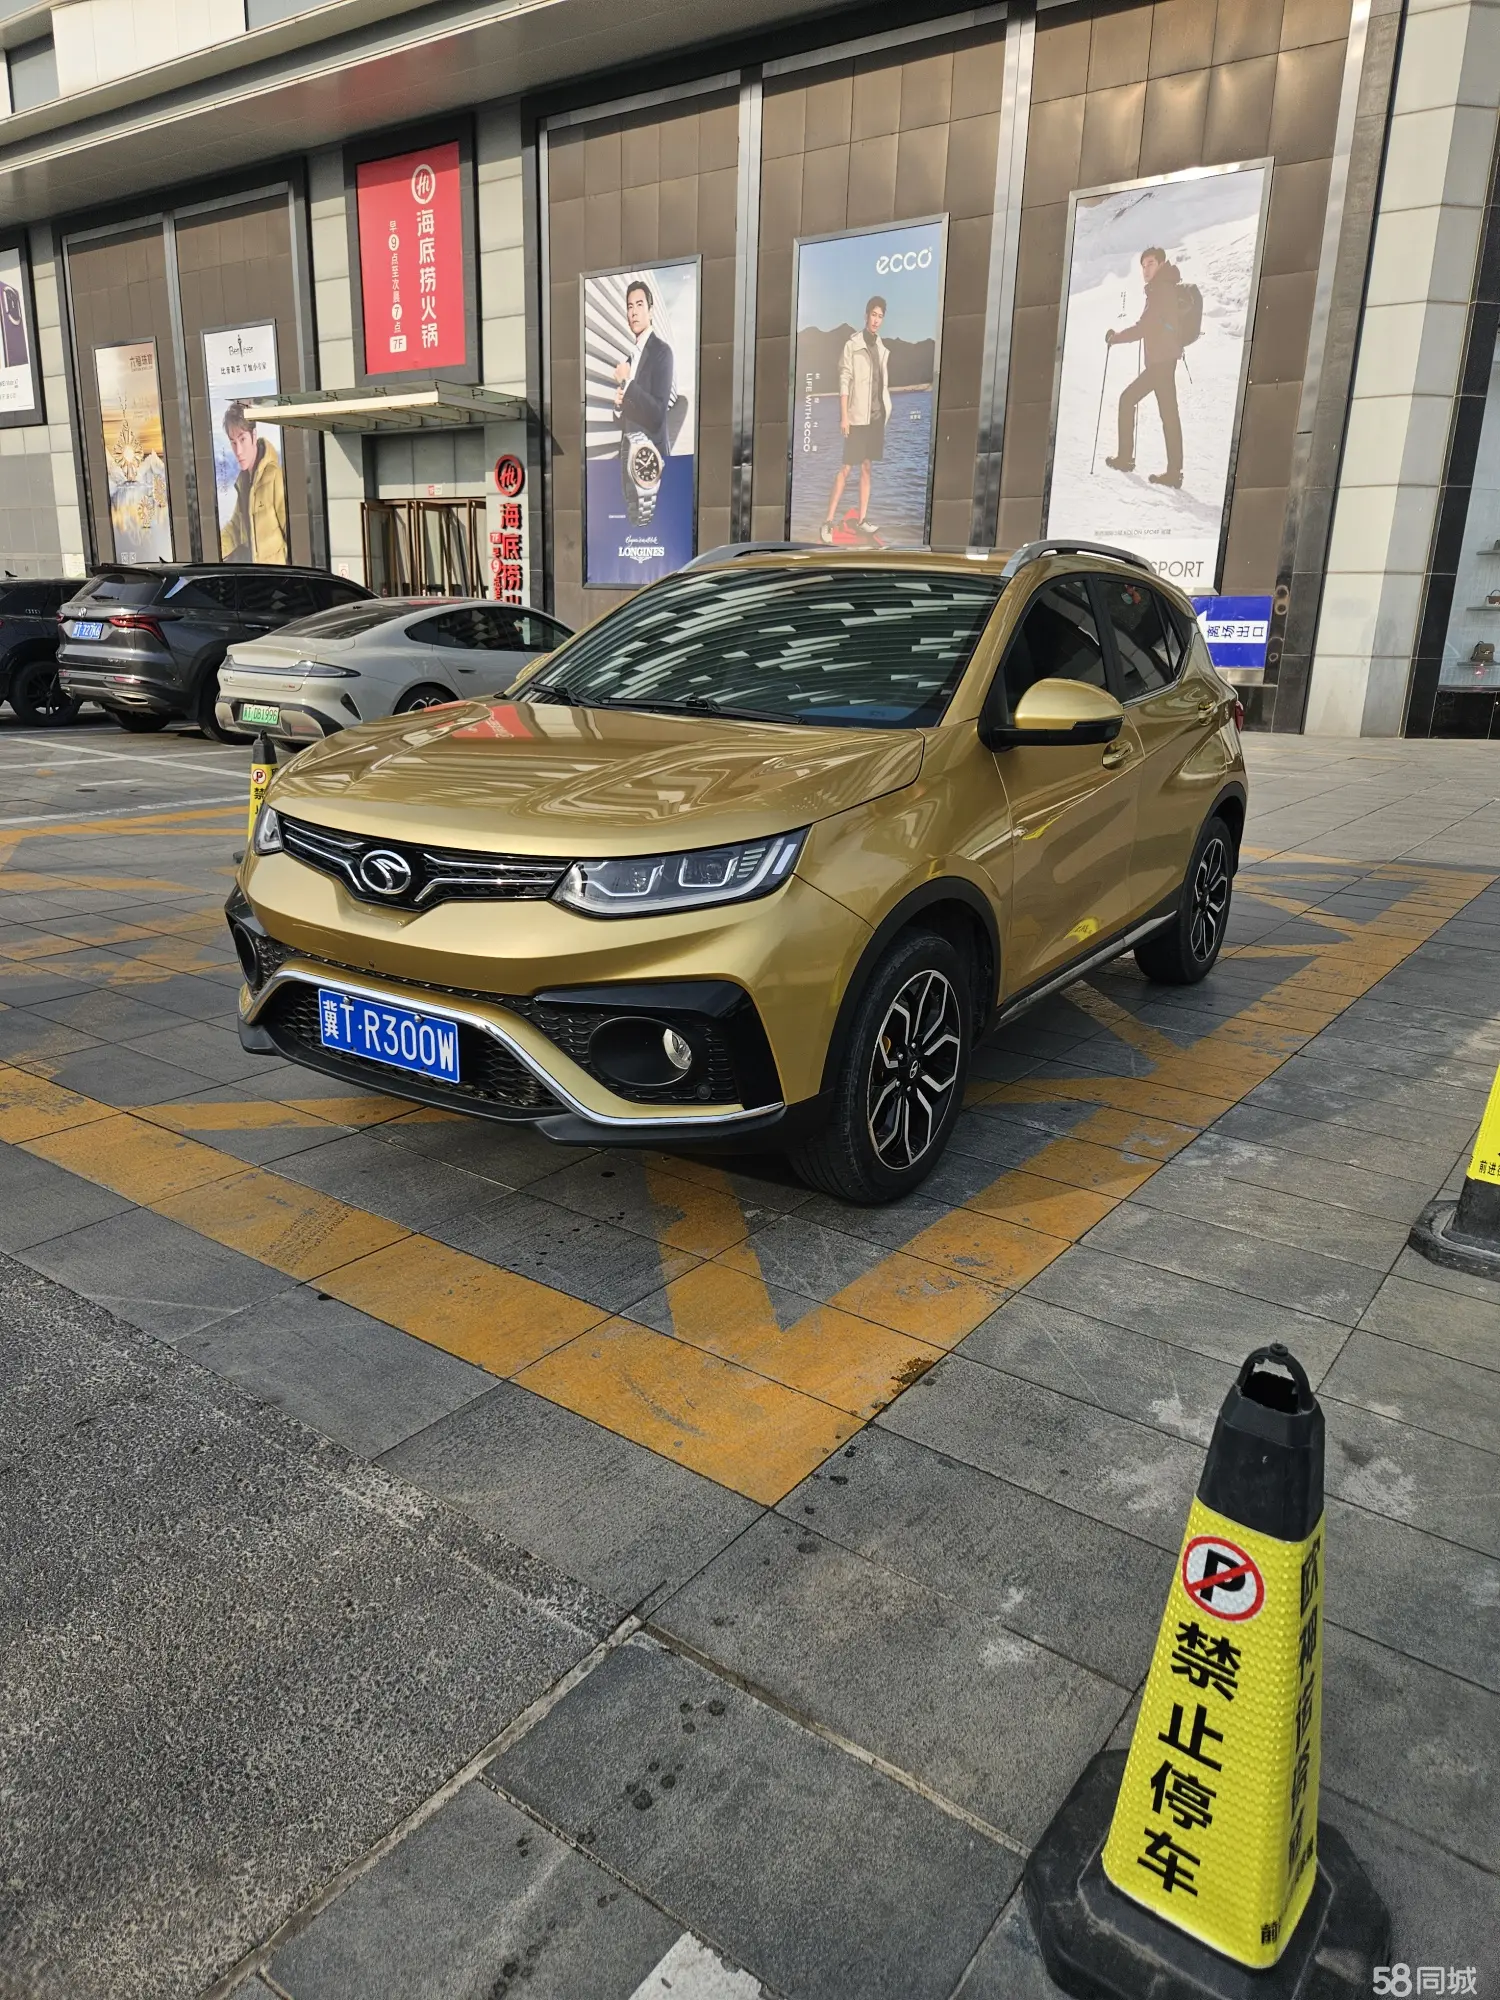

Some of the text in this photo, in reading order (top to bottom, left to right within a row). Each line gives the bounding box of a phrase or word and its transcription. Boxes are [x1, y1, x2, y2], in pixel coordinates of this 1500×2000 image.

[876, 249, 932, 274] ecco
[416, 209, 438, 348] 海底捞火锅
[618, 546, 665, 557] LONGINES
[1207, 625, 1264, 638] 离场出口
[1136, 1621, 1242, 1897] 禁止停车
